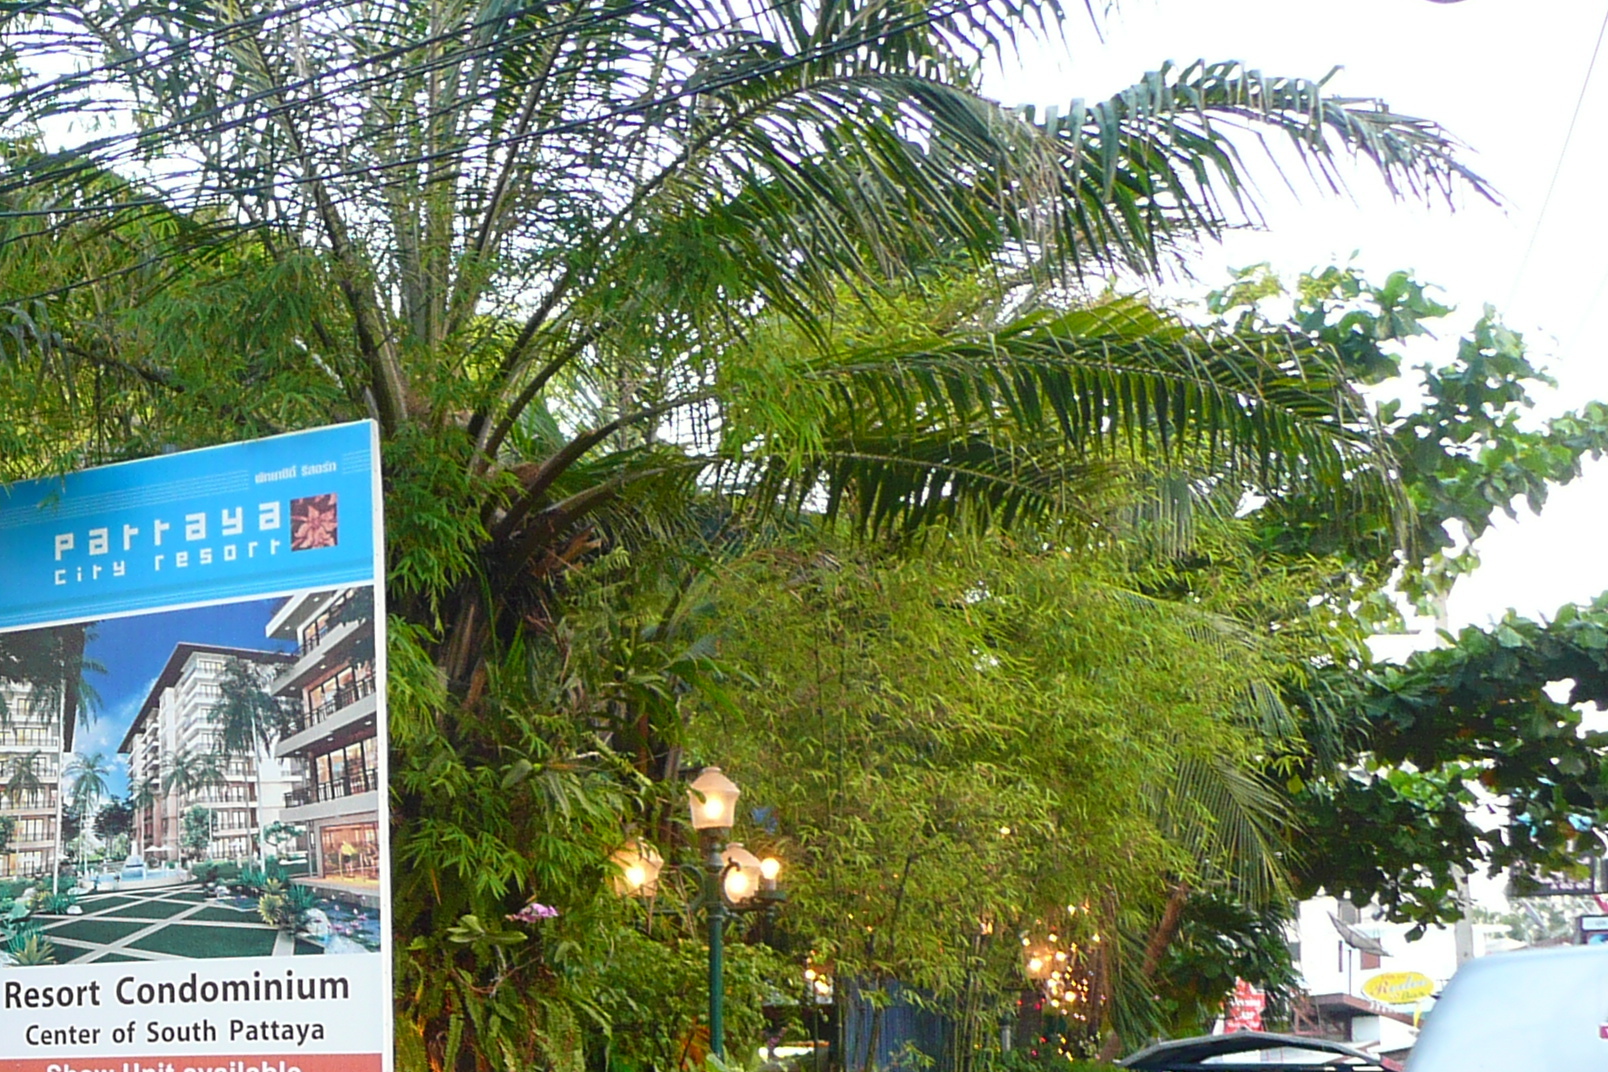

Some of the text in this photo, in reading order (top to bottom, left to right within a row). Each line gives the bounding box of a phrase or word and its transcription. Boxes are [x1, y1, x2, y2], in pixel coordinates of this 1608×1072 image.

[4, 970, 350, 1009] Resort Condominium
[25, 1018, 326, 1047] Center of South Pattaya
